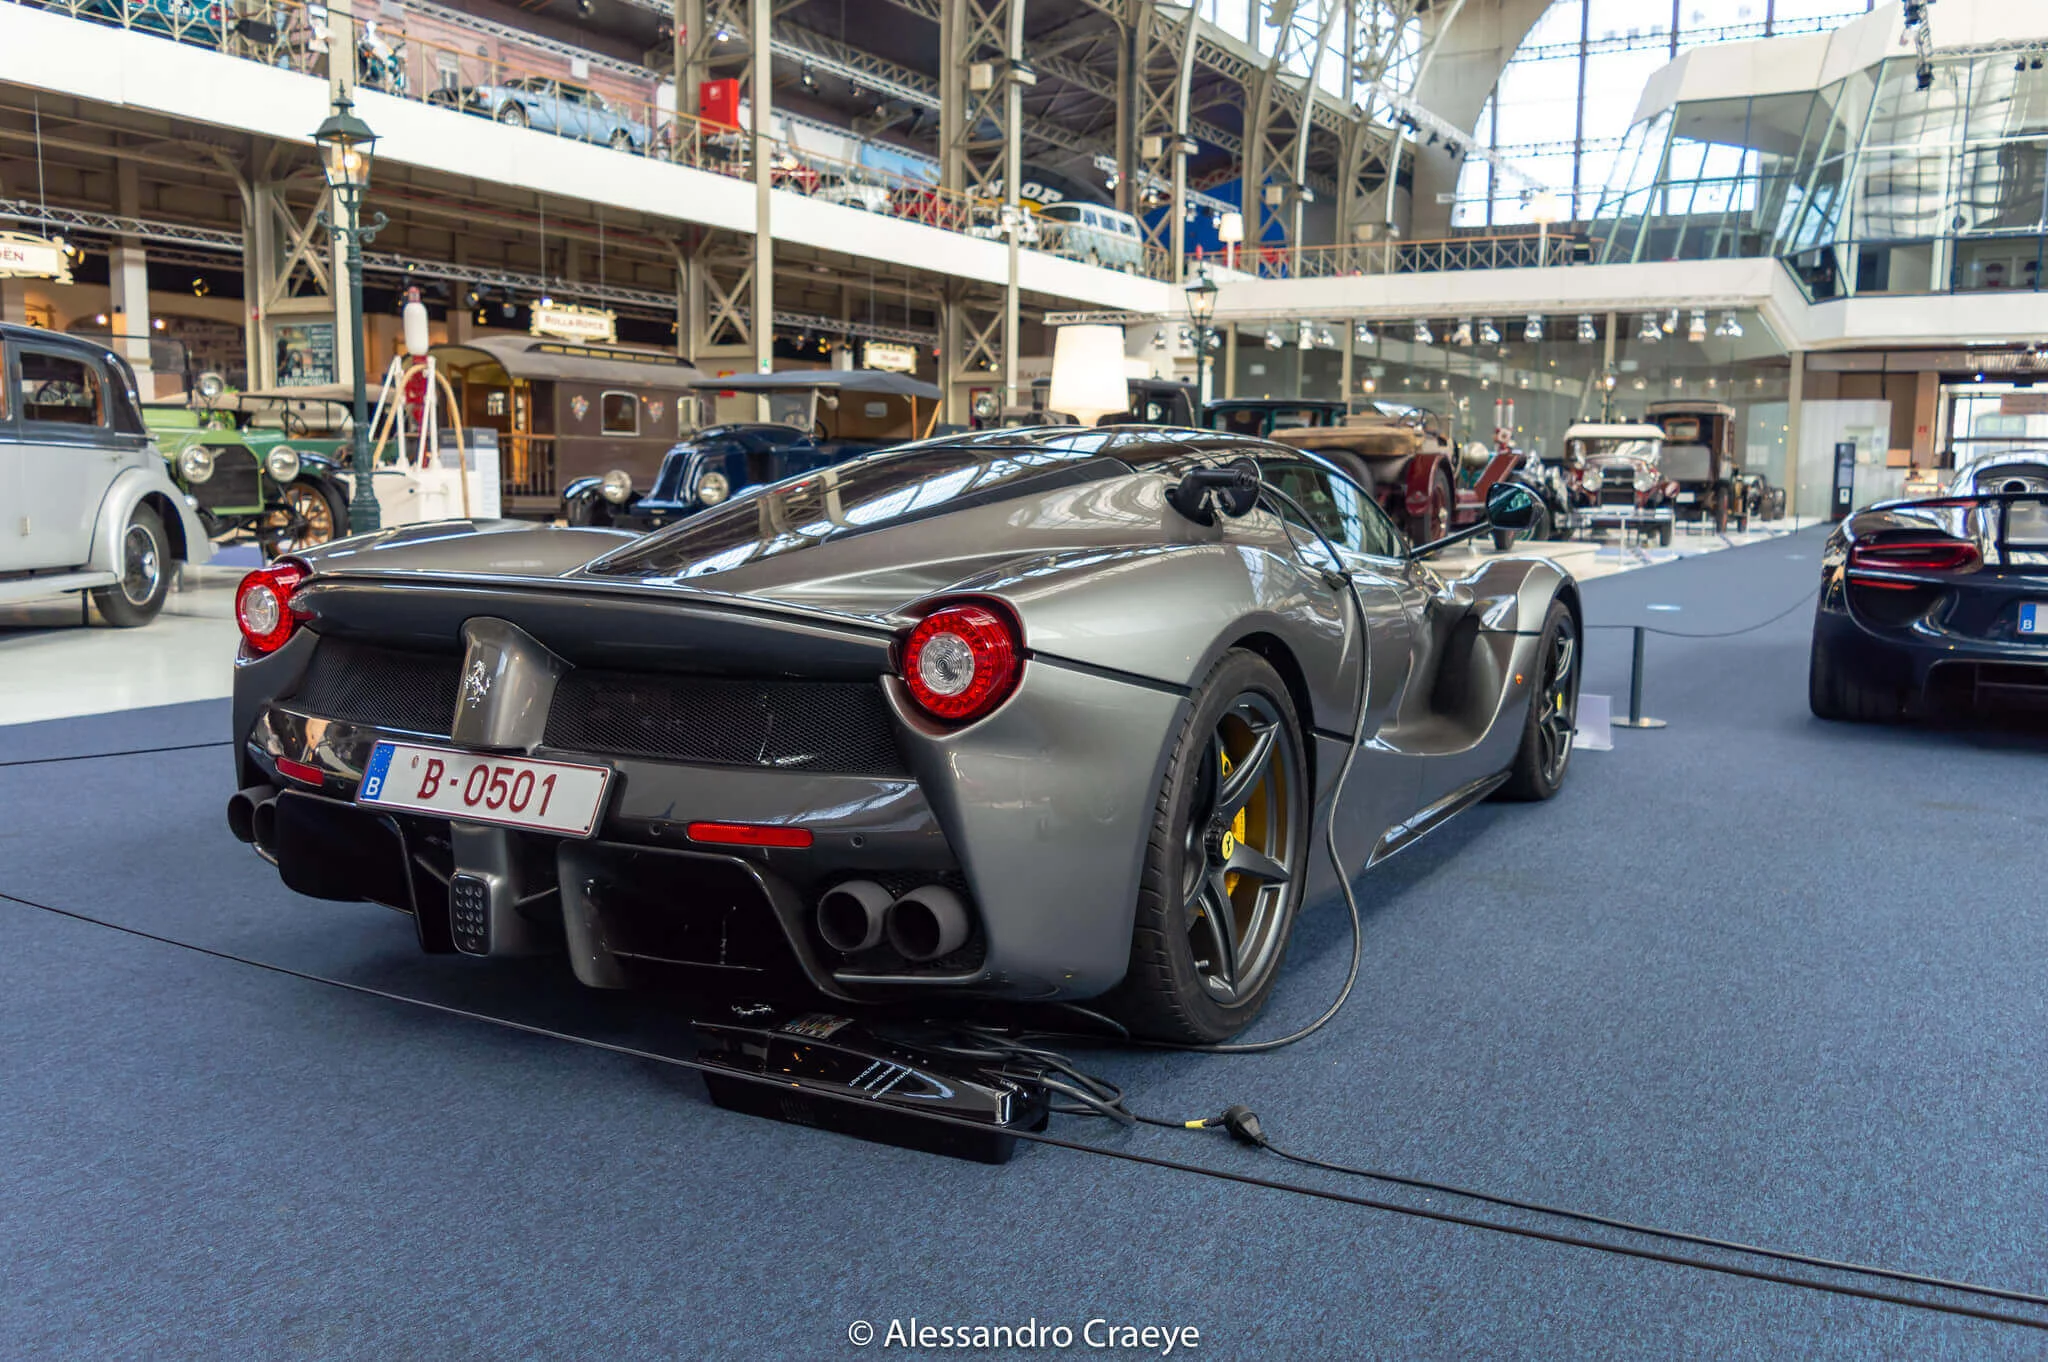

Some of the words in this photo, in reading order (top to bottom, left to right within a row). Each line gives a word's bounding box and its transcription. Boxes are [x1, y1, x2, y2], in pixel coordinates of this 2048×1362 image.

[0, 245, 24, 262] ËN
[2023, 619, 2033, 631] B
[365, 777, 382, 796] B
[417, 758, 557, 817] B-0501
